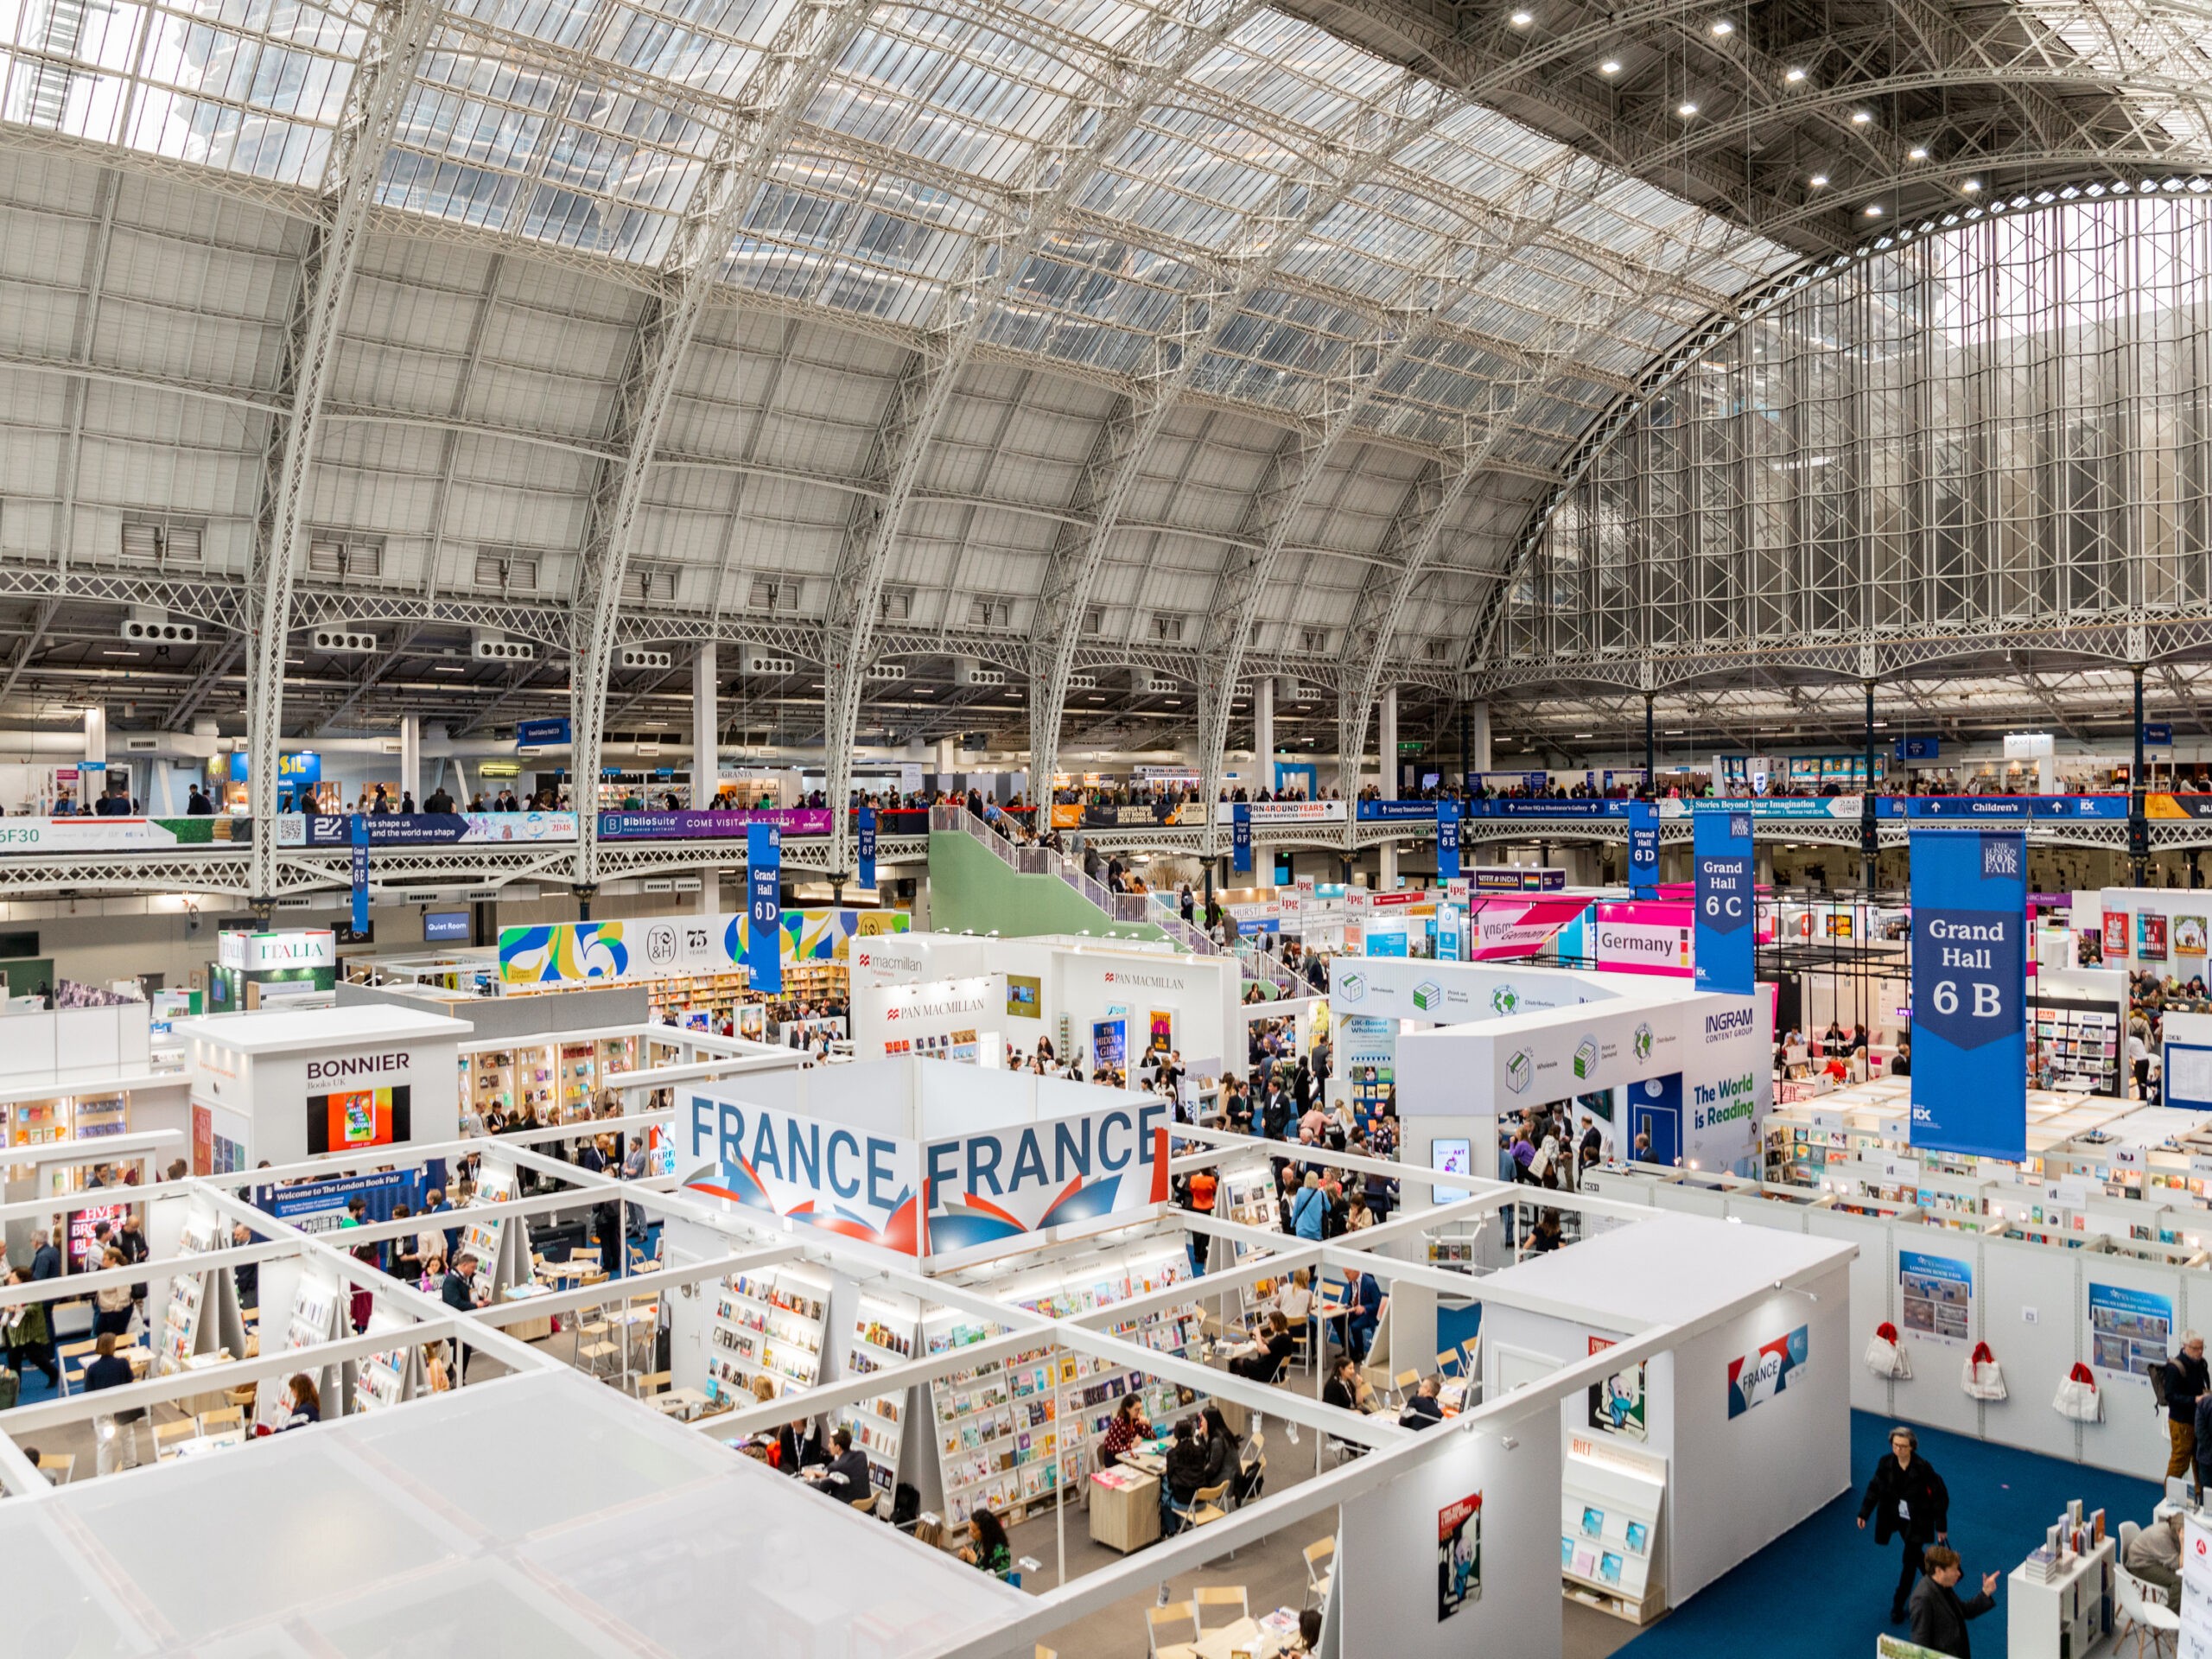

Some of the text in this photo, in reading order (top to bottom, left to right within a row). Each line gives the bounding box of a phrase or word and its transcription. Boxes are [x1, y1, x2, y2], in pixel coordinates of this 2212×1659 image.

[721, 770, 753, 779] GRANTA
[1695, 800, 1719, 809] Stories
[1721, 800, 1749, 810] Beyond
[1770, 800, 1815, 809] Imagination
[1973, 803, 2018, 812] Children's
[378, 820, 400, 830] shape
[623, 817, 676, 826] BiblioSuite
[686, 819, 713, 828] COME
[716, 818, 739, 828] VISIT
[434, 829, 455, 837] shape
[1236, 835, 1249, 843] 6 F
[1442, 837, 1456, 847] 6 E
[1637, 838, 1651, 847] Hall
[862, 845, 874, 855] 6 F
[1634, 849, 1656, 861] 6 D
[1986, 848, 2017, 856] LONDON
[1986, 855, 2017, 865] BOOK
[1703, 861, 1742, 874] Grand
[1986, 863, 2018, 874] FAIR
[354, 869, 365, 882] 6 E
[754, 869, 776, 881] Grand
[1297, 879, 1313, 892] ipg
[1710, 877, 1736, 890] Hall
[758, 885, 772, 896] Hall
[1450, 884, 1466, 897] ipg
[1281, 897, 1299, 910] ipg
[1347, 893, 1363, 906] ipg
[754, 902, 777, 921] 6 D
[1706, 895, 1742, 918] 6 C
[428, 921, 467, 931] Quiet Room
[1929, 919, 2005, 942] Grand
[1602, 932, 1673, 956] Germany
[260, 944, 324, 960] ITALIA
[1942, 948, 1992, 969] Hall
[873, 955, 922, 972] macmillan
[1116, 972, 1184, 990] PAN MACMILLAN
[1933, 981, 2002, 1018] 6 B
[901, 998, 984, 1020] PAN MACMILLAN
[1706, 1008, 1753, 1033] INGRAM
[1103, 1026, 1115, 1035] THE
[1706, 1027, 1753, 1044] CONTENT GROUP
[1096, 1035, 1122, 1046] HIDDEN
[1100, 1045, 1118, 1057] GIRL
[307, 1052, 410, 1079] BONNIER
[307, 1078, 346, 1090] Books UK
[1694, 1073, 1753, 1106] The World
[1694, 1099, 1754, 1130] is Reading
[692, 1096, 898, 1207] FRANCE
[928, 1104, 1166, 1210] FRANCE
[276, 1190, 312, 1201] Welcome
[337, 1180, 365, 1192] London
[365, 1178, 385, 1188] Book
[385, 1175, 399, 1184] Fair
[85, 1205, 114, 1222] FIVE
[1743, 1359, 1777, 1392] FRANCE
